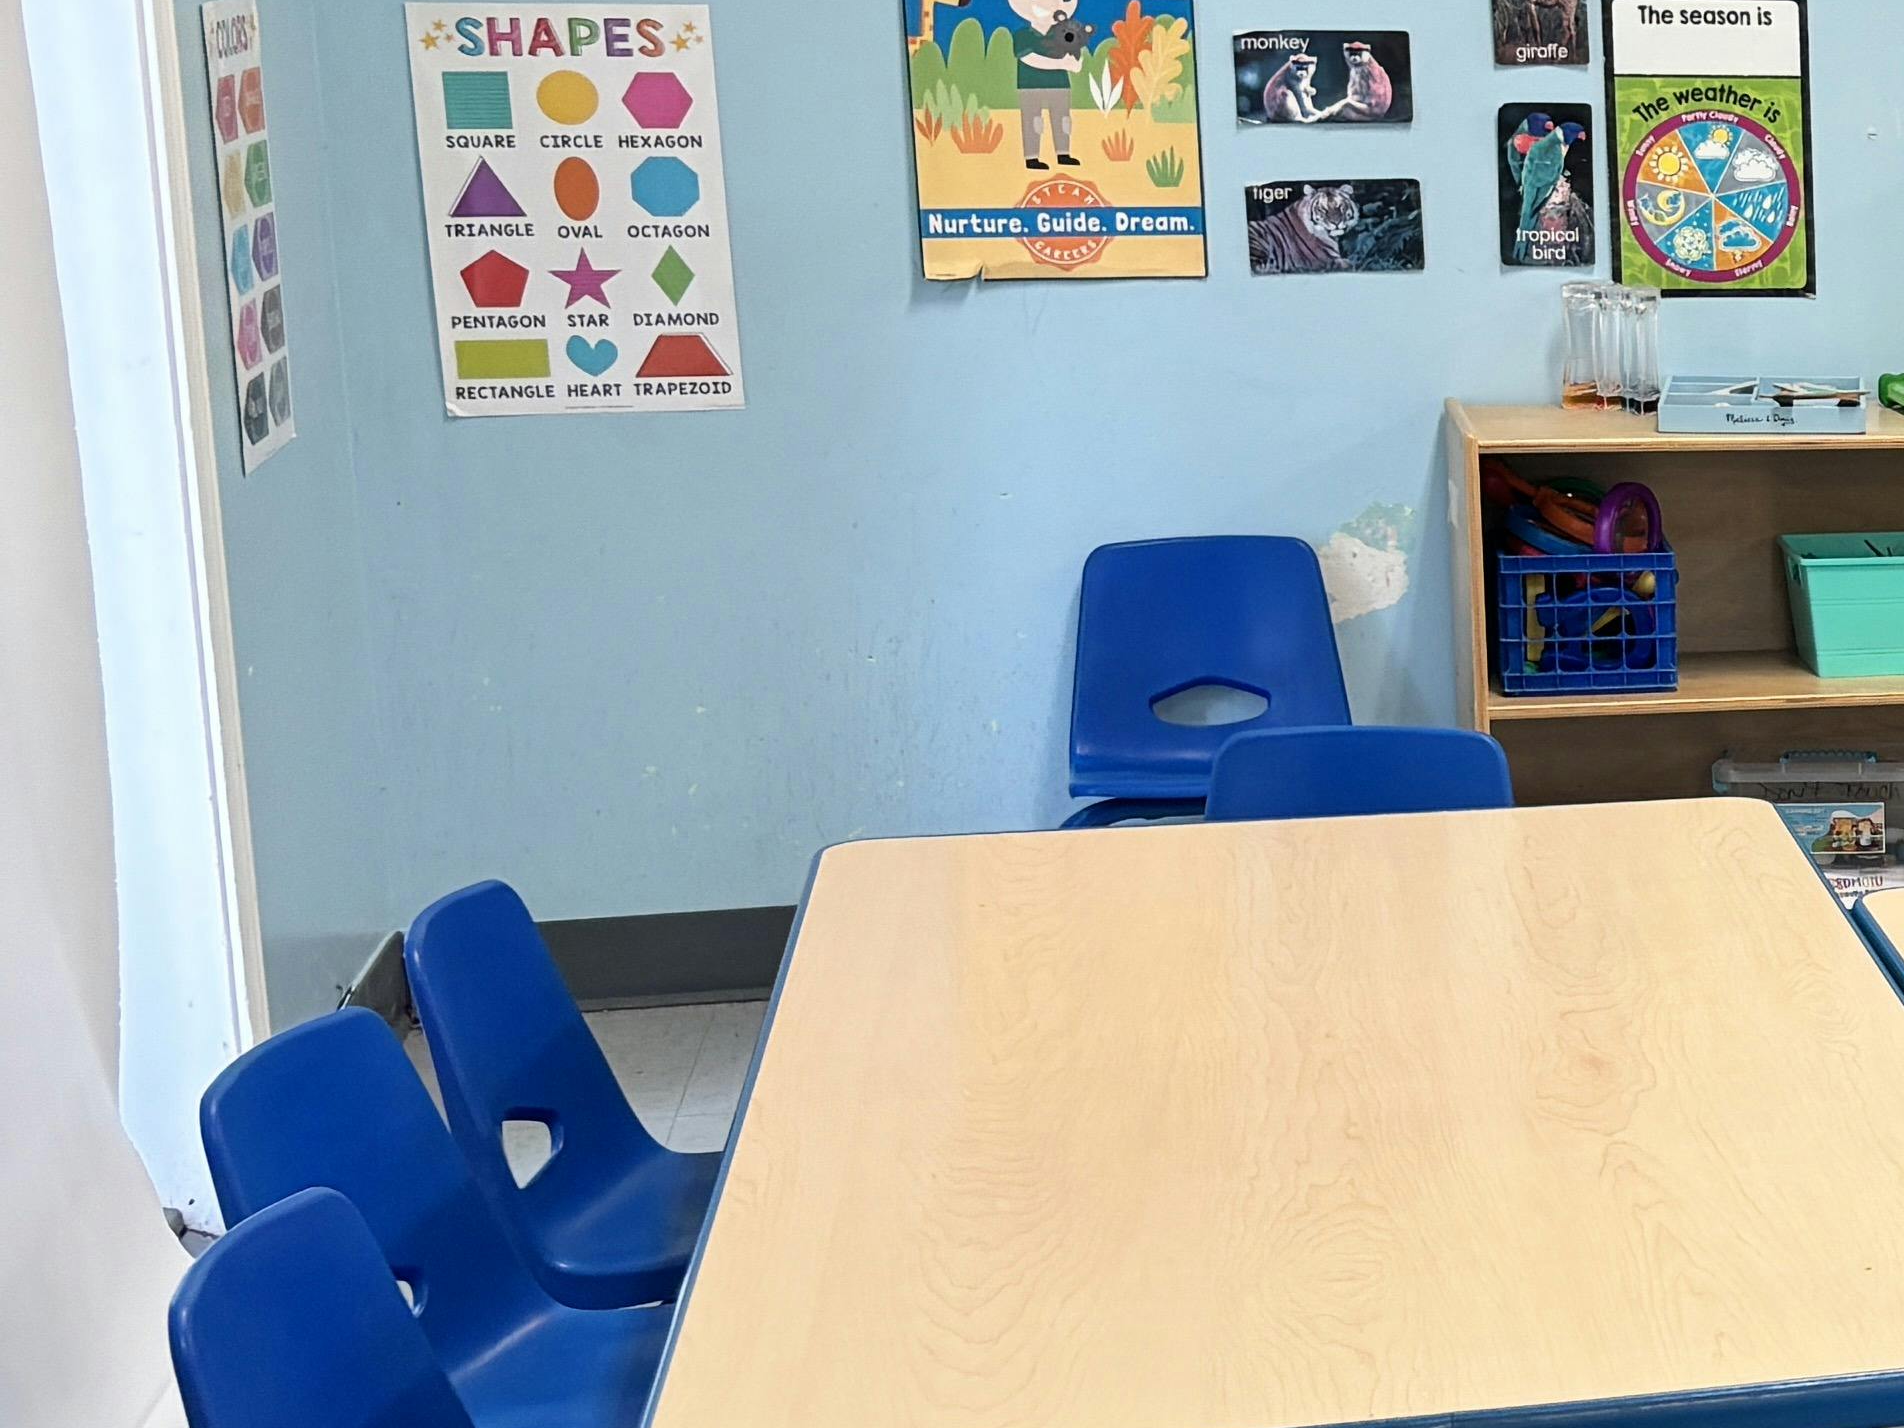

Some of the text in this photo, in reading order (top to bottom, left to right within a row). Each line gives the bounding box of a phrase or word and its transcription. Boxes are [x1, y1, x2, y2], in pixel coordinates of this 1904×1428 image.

[1637, 5, 1773, 26] The season is
[454, 16, 666, 58] SHAPES
[1240, 35, 1310, 56] monkey
[1516, 43, 1568, 62] giraffe
[1632, 84, 1782, 123] The weather is
[446, 134, 516, 149] SQUARE
[539, 134, 603, 149] CIRCLE
[617, 134, 703, 149] HEXAGON
[1253, 184, 1292, 203] tiger
[444, 222, 534, 238] TRIANGLE
[928, 211, 1195, 233] Nurture. Guide. Dream.
[557, 224, 603, 240] OVAL
[627, 224, 710, 239] OCTAGON
[1516, 227, 1579, 246] tropical
[1532, 245, 1566, 260] bird
[450, 314, 546, 330] PENTAGON
[567, 313, 610, 329] STAR
[632, 312, 720, 327] DIAMOND
[455, 384, 555, 400] RECTANGLE
[567, 383, 622, 399] HEART
[633, 380, 732, 397] TRAPEZOID
